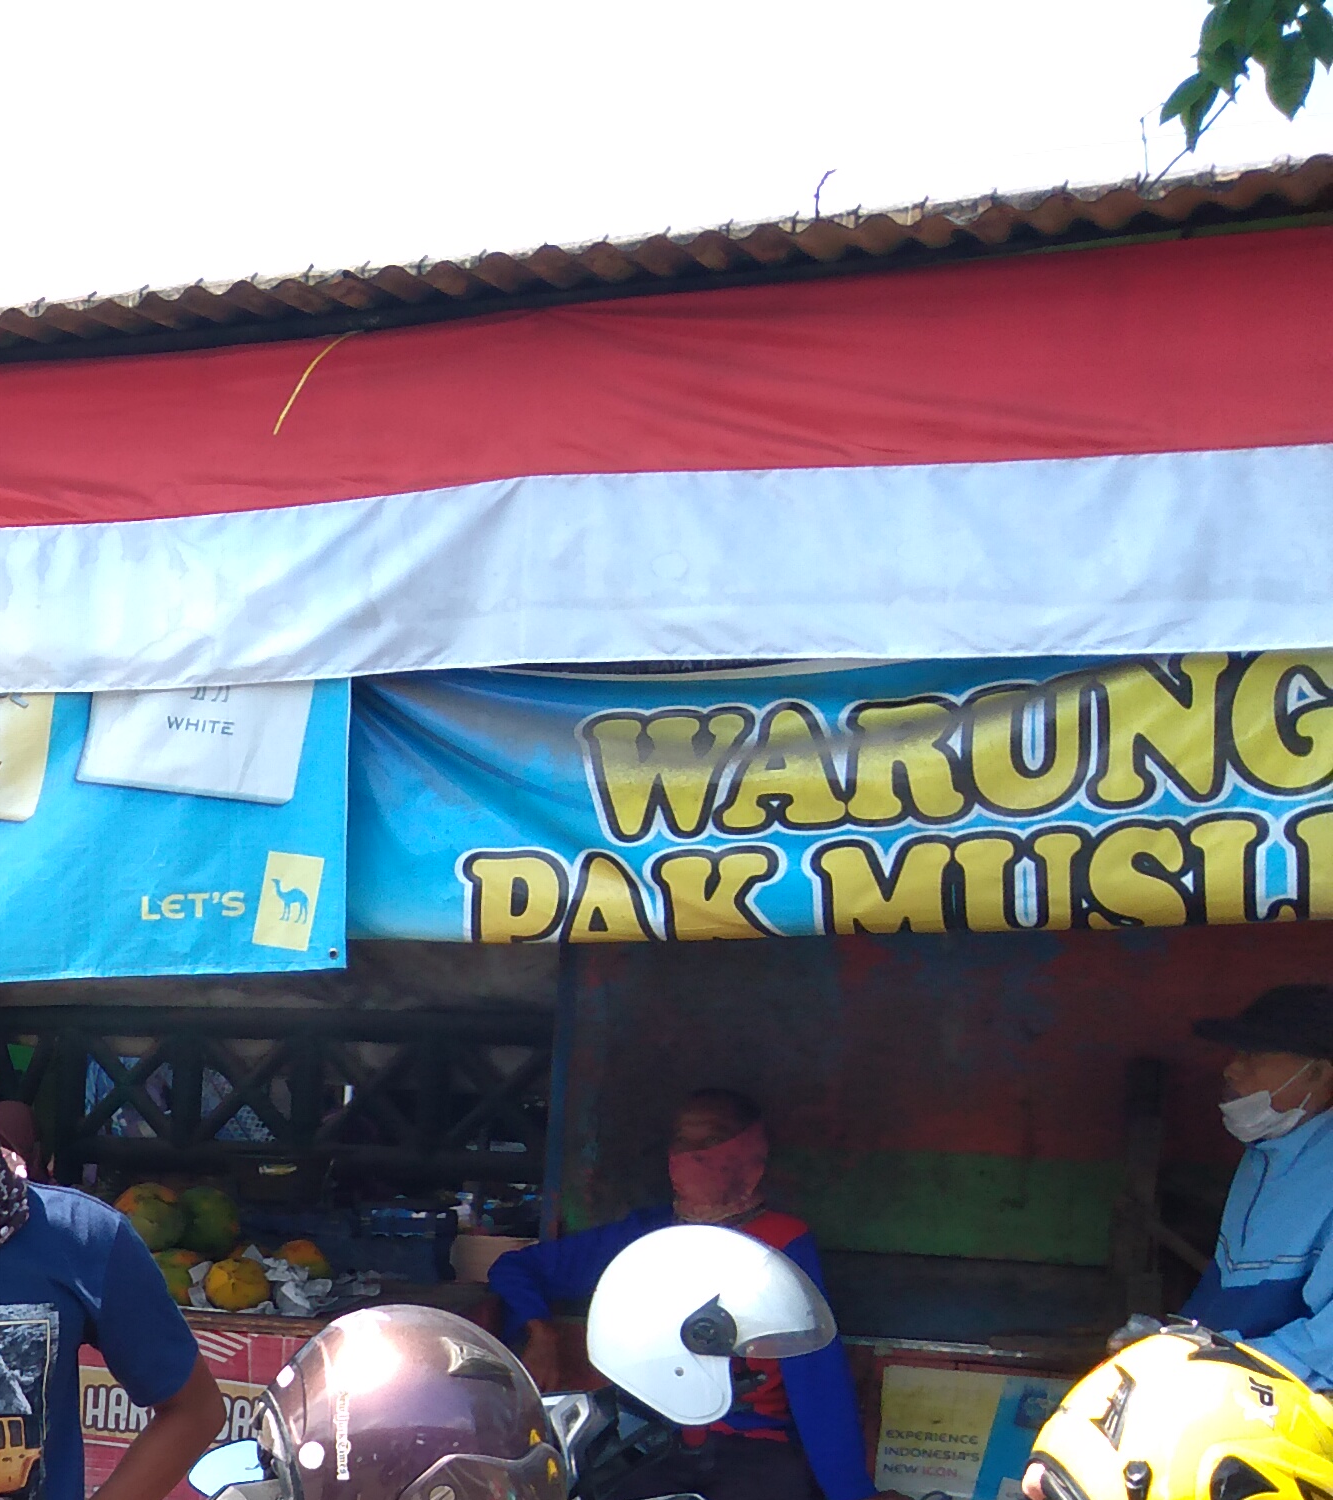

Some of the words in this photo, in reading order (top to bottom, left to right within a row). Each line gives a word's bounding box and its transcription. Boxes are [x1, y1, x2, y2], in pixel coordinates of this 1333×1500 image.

[166, 714, 235, 736] WHITE
[583, 650, 1333, 844] WARUNG
[140, 890, 246, 921] LET'S
[467, 846, 785, 943] PAK
[885, 1429, 979, 1445] EXPERIENCE
[883, 1463, 918, 1475] NEW
[922, 1465, 958, 1478] ICON
